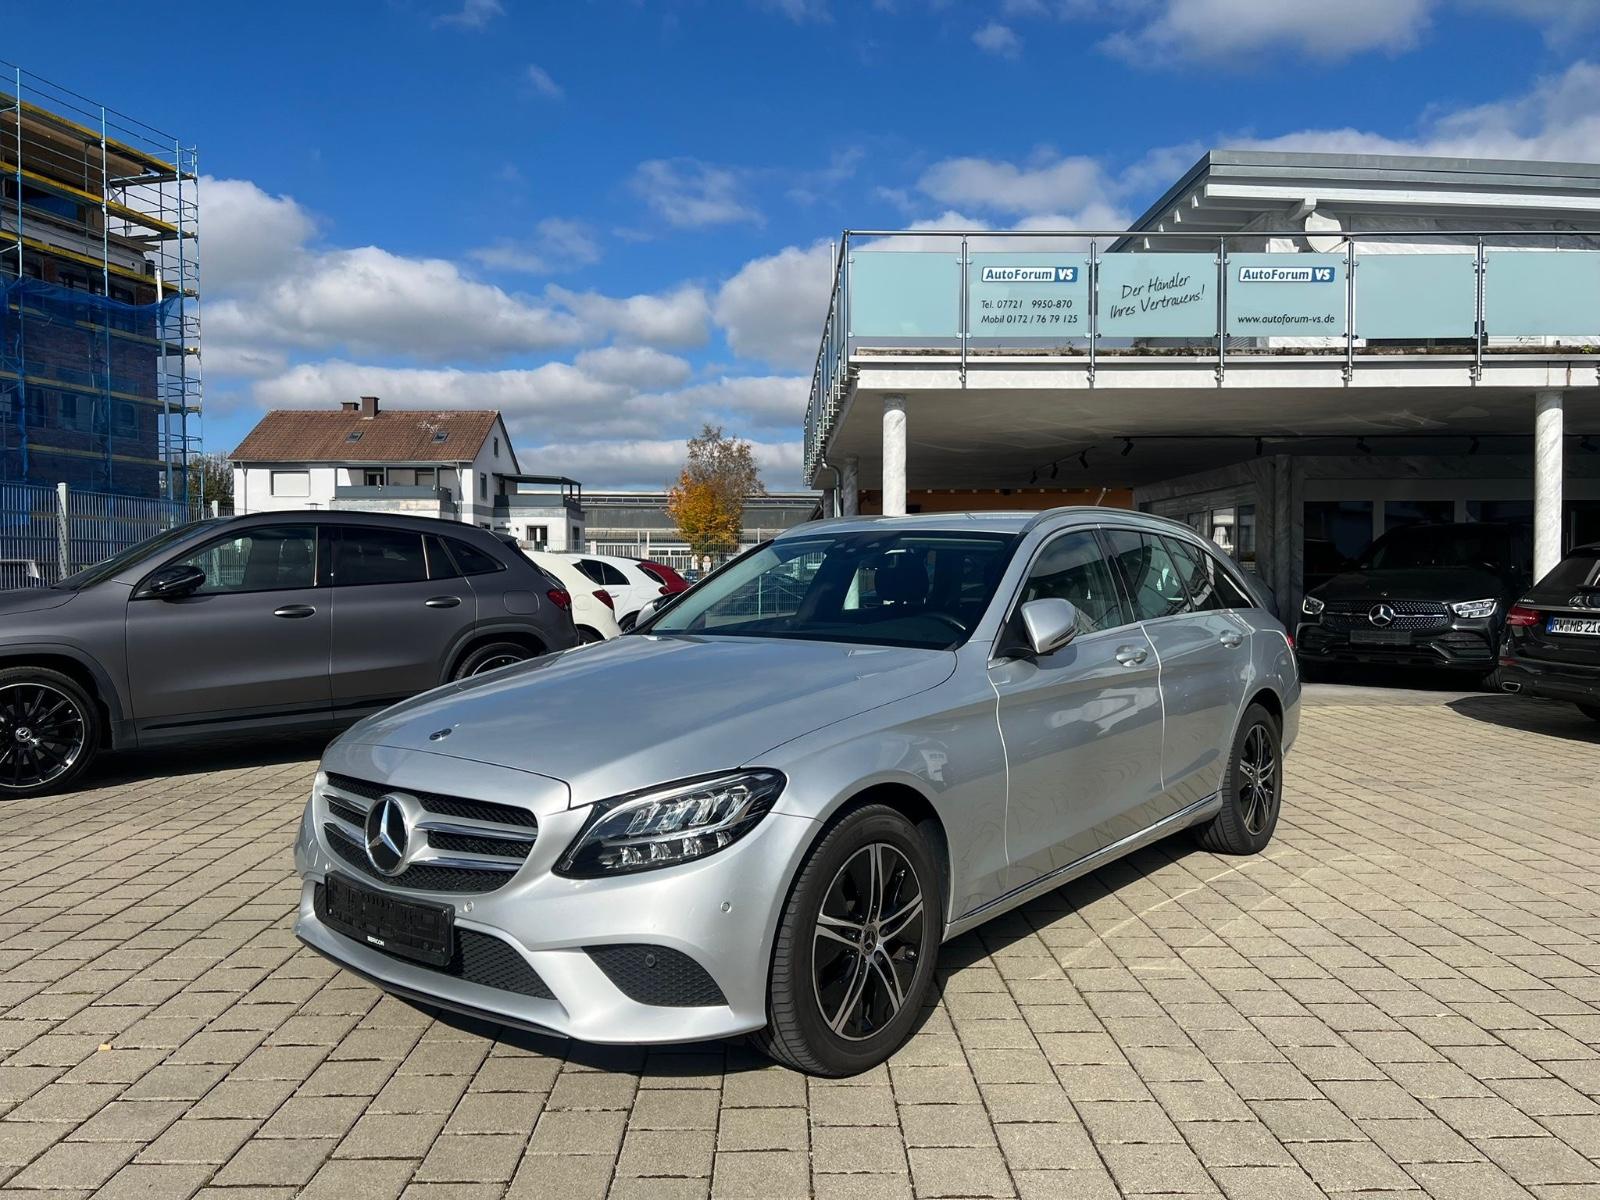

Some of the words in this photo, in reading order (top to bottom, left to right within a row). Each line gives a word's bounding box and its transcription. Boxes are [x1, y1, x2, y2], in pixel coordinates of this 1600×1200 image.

[985, 269, 1052, 280] AutoForum
[1058, 268, 1074, 280] VS
[1242, 269, 1309, 280] AutoForum
[1315, 268, 1331, 280] VS
[1121, 284, 1144, 299] Der
[981, 300, 994, 309] Tel.
[996, 300, 1023, 309] 07721
[1031, 300, 1073, 309] 9950-870
[1110, 304, 1136, 319] Ihres
[1140, 284, 1205, 312] Vertrauens!
[981, 314, 1005, 324] Mobil
[1237, 314, 1335, 325] www.autoforum-vs.de
[1584, 620, 1600, 633] 21
